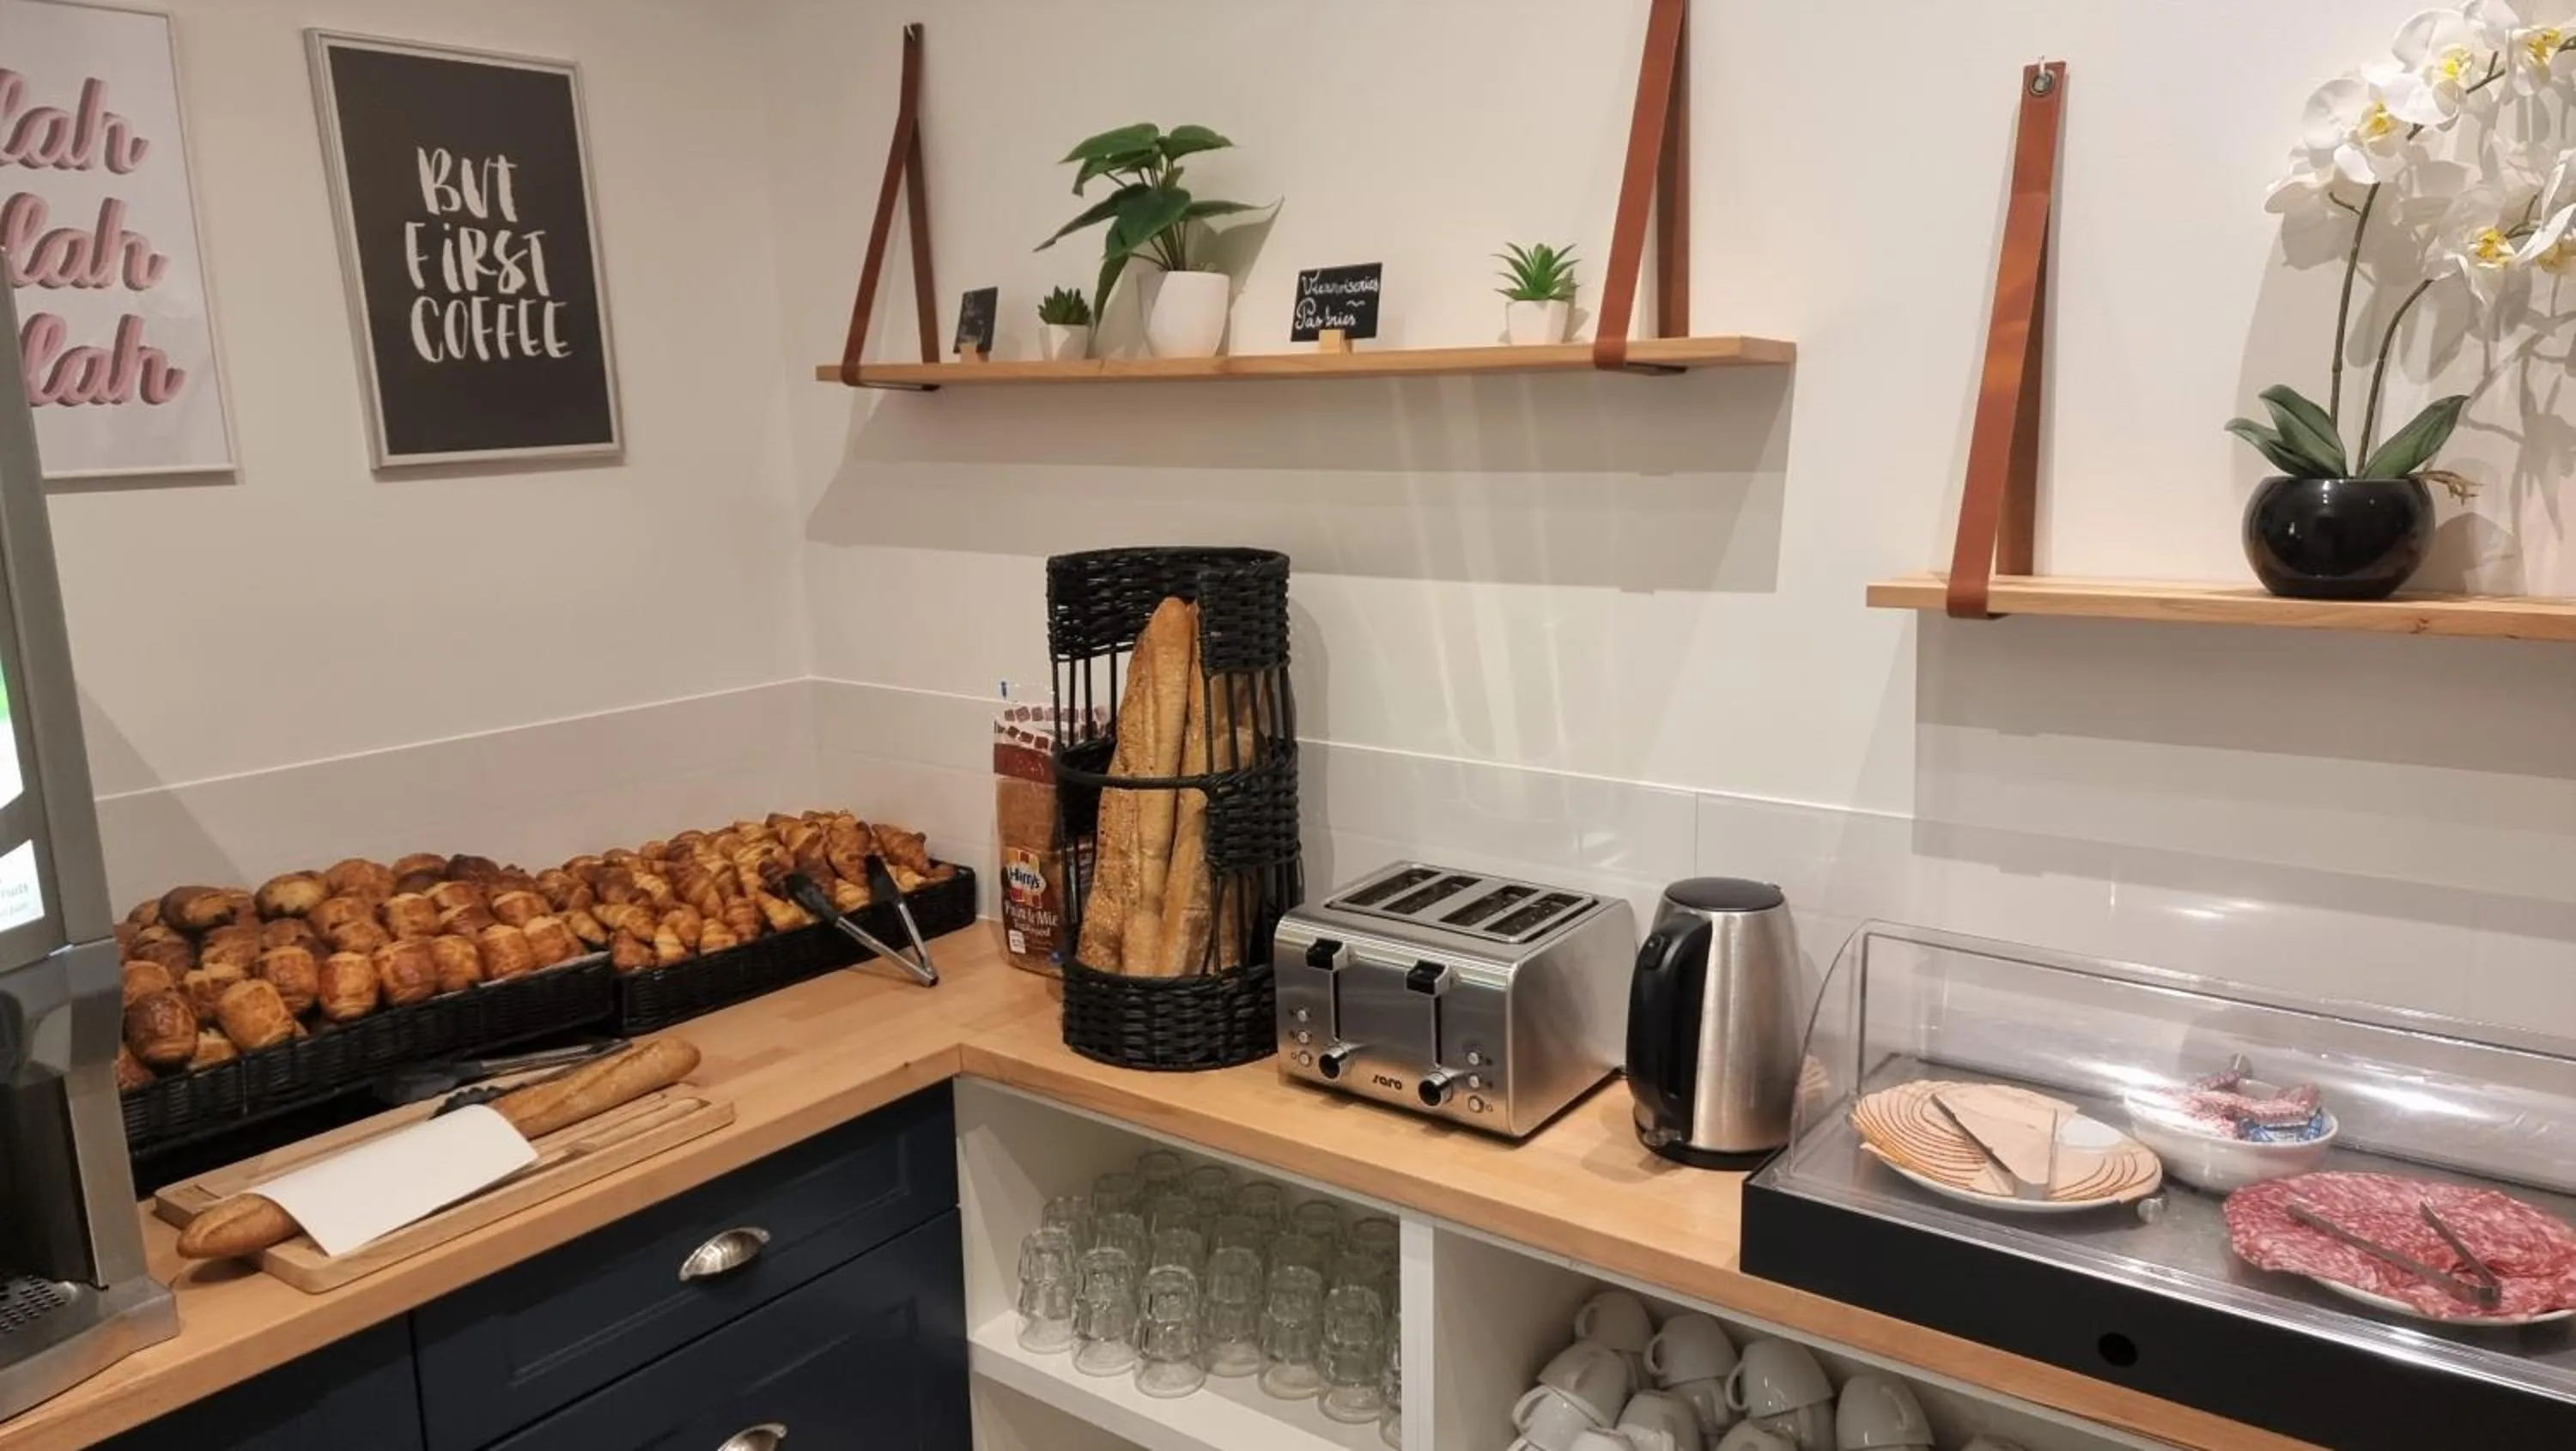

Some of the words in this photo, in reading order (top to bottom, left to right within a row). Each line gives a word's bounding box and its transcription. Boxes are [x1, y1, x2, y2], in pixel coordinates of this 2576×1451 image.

[417, 146, 518, 222] BUT
[410, 296, 573, 362] COFFEE
[1373, 1074, 1402, 1090] saro
